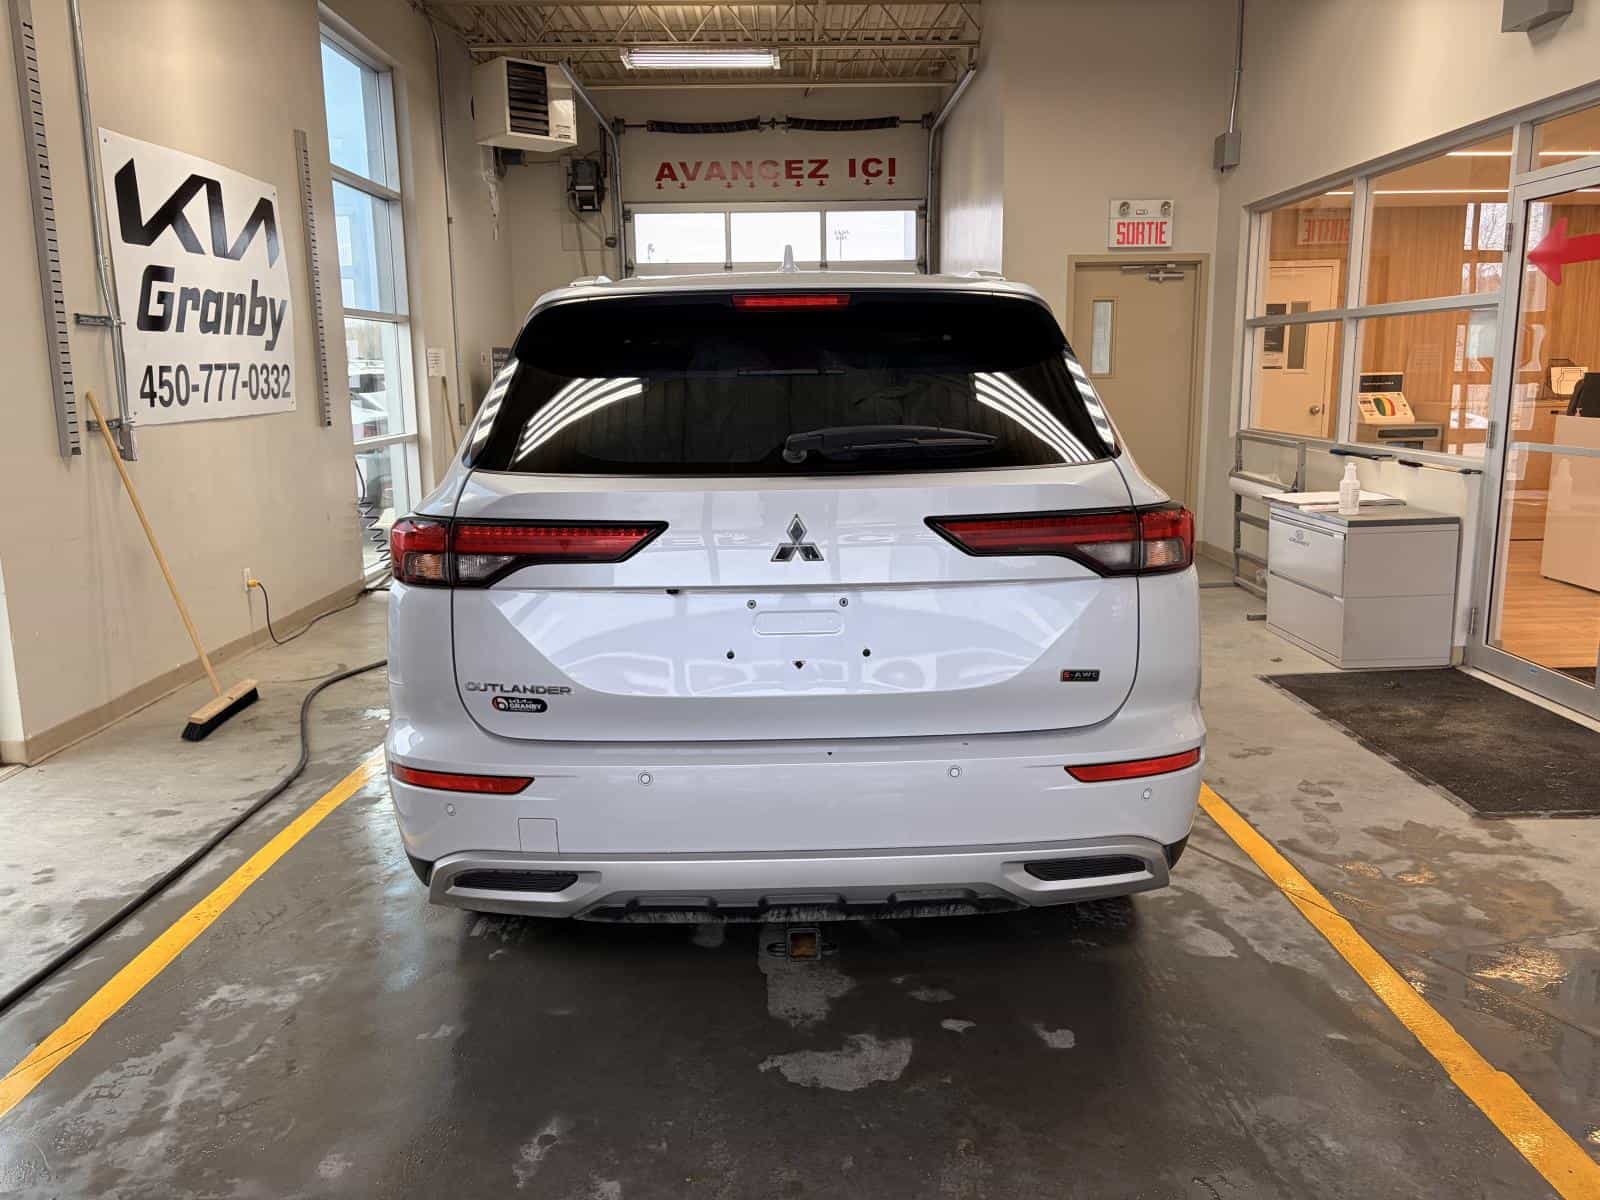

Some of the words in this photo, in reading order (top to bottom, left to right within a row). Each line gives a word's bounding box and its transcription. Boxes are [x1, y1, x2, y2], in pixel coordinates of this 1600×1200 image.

[655, 158, 830, 182] AVANCEZ
[114, 157, 280, 268] KIA
[1117, 221, 1168, 245] SORTIE
[137, 264, 288, 351] Granby
[139, 363, 291, 407] 450-777-0332
[465, 681, 573, 695] OUTLANDER
